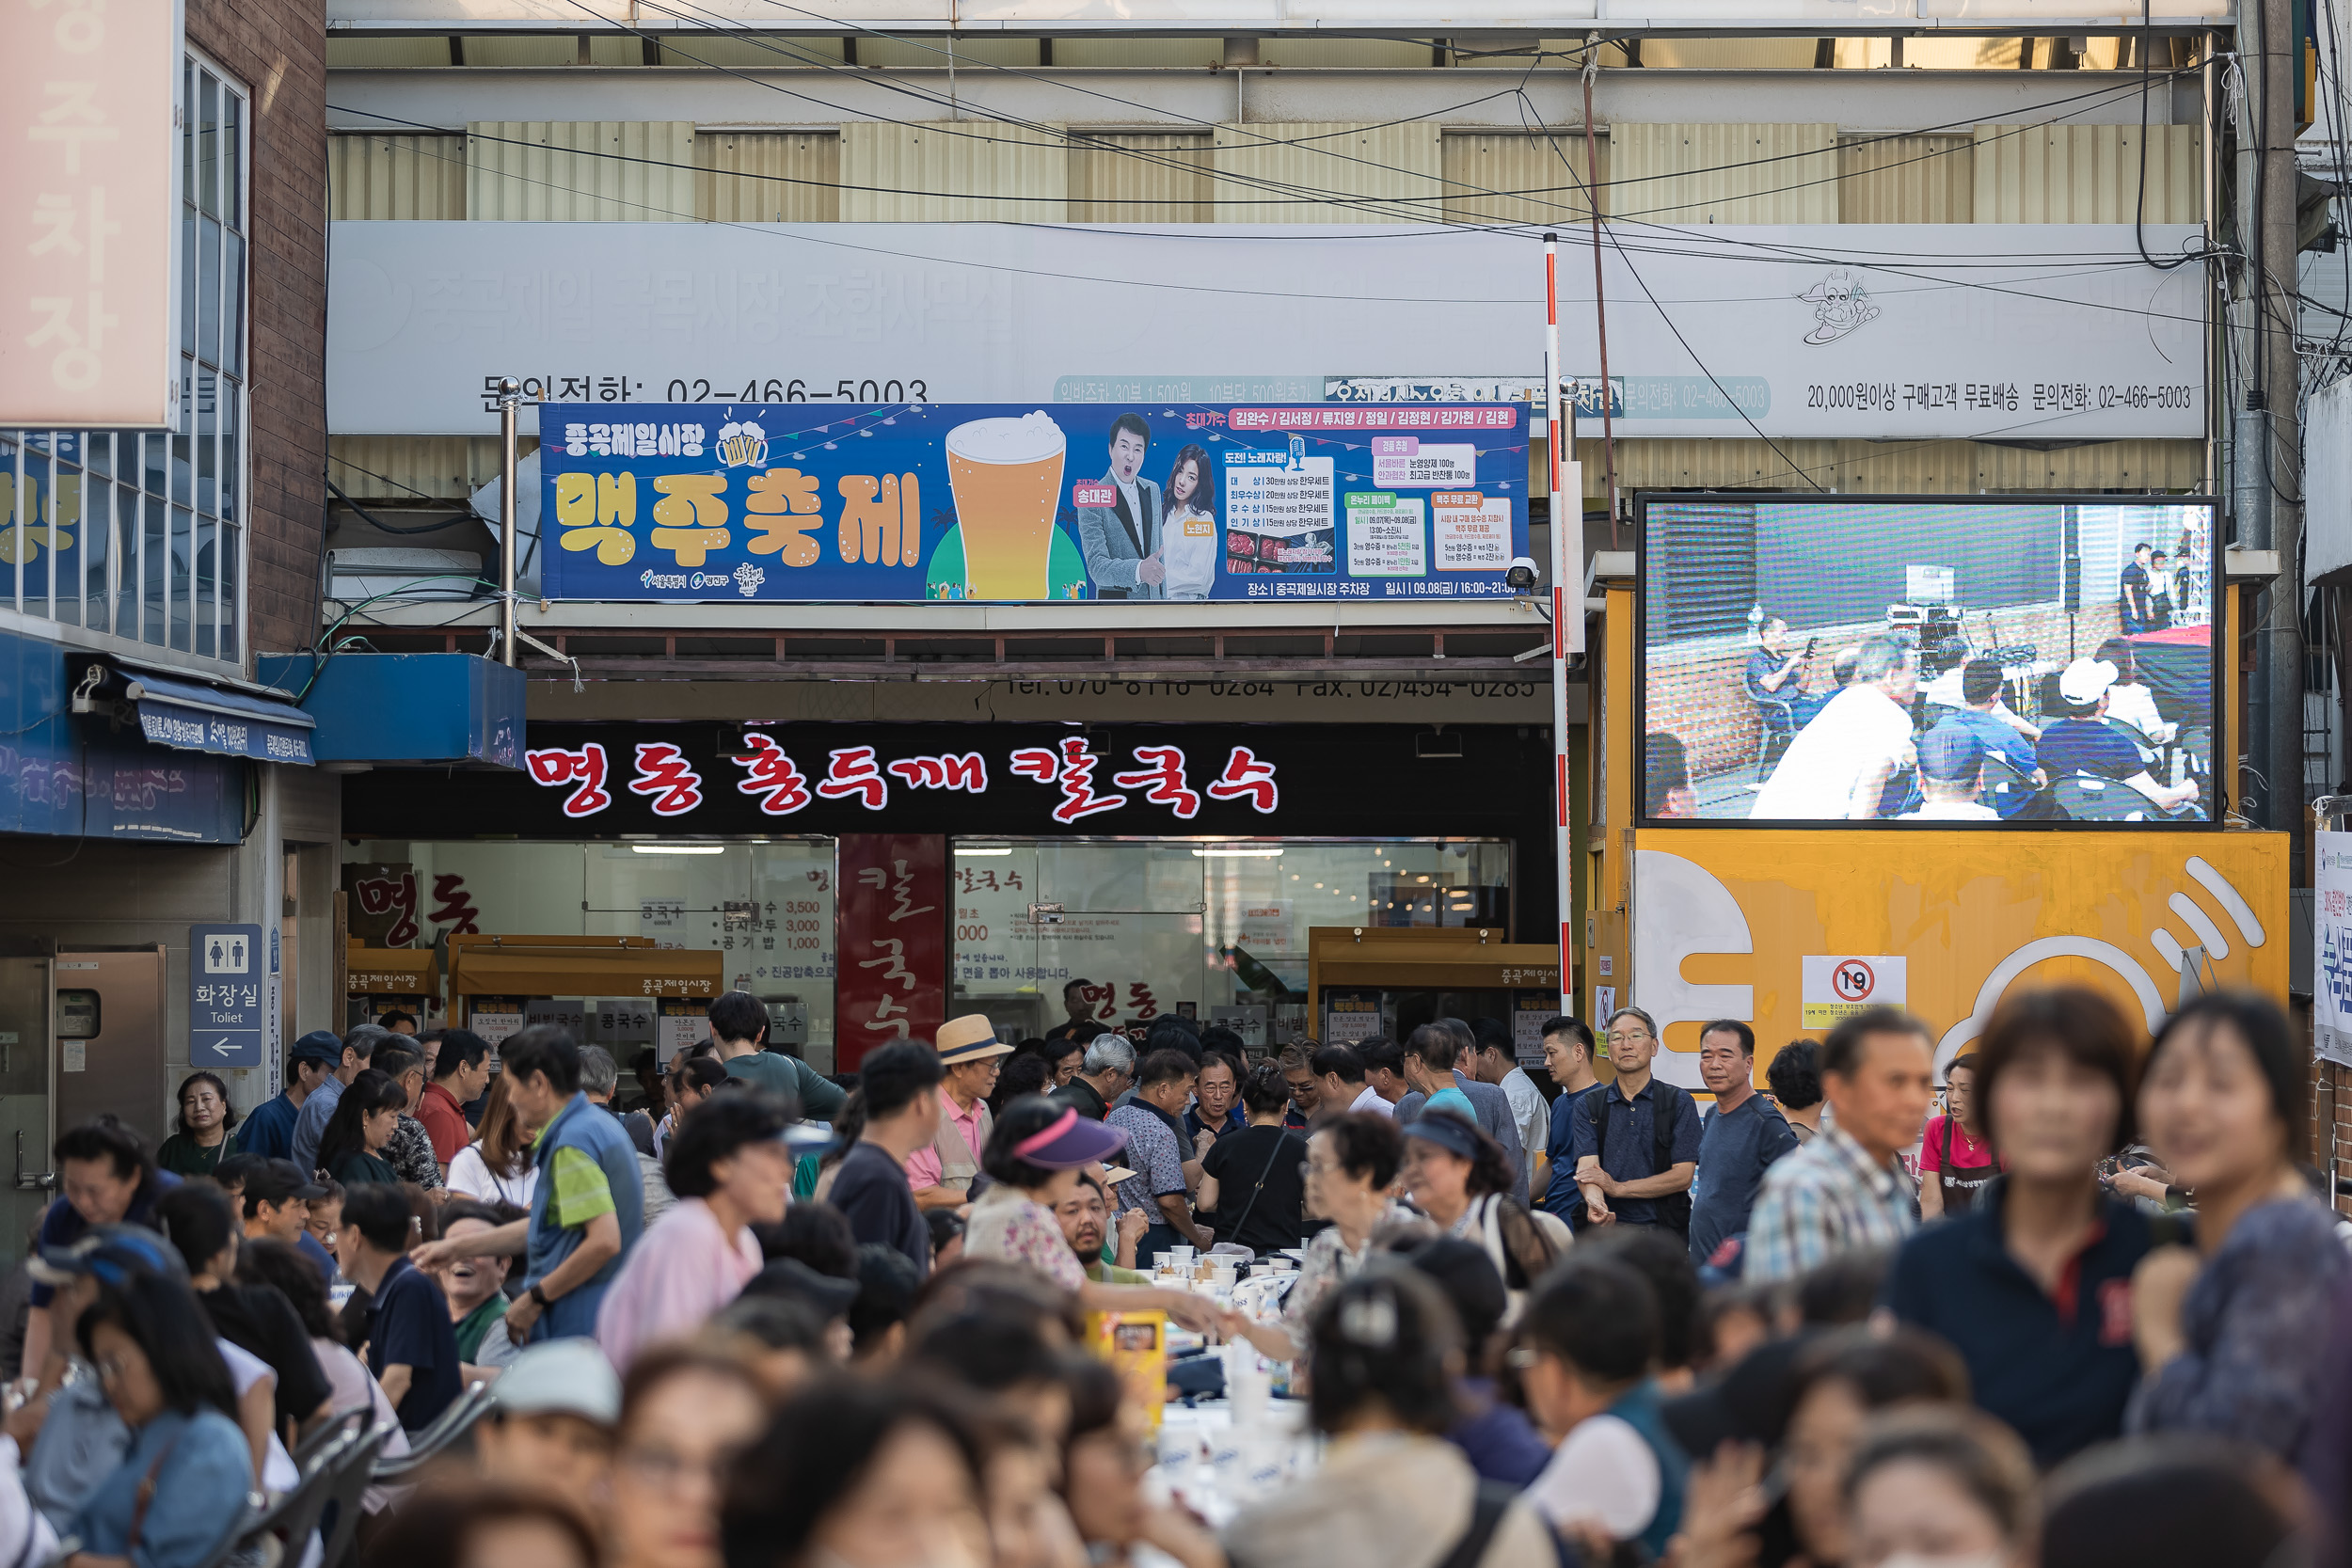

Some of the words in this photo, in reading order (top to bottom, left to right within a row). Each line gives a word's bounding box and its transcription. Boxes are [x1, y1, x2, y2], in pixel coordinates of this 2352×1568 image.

[667, 378, 929, 403] 02-466-5003
[1682, 384, 1765, 409] 02-466-5003
[1807, 381, 1897, 413] 20,000원이상
[1902, 382, 1958, 411] 구매고객
[1963, 382, 2020, 411] 무료배송
[2032, 382, 2093, 411] 문의전화:
[2098, 384, 2192, 410] 02-466-5003
[1185, 412, 1227, 427] 초대가수
[1235, 411, 1269, 426] 김완수
[1279, 411, 1312, 426] 김서정
[1322, 411, 1356, 426] 류지영
[1365, 411, 1388, 426] 정일
[1398, 411, 1431, 426] 김정현
[1440, 411, 1474, 426] 김가현
[1486, 411, 1509, 426] 김현
[564, 422, 706, 457] 중곡제일시장
[1225, 451, 1247, 464] 도전!
[1248, 451, 1287, 464] 노래자랑!
[1409, 458, 1438, 468] 눈영양제
[1299, 476, 1329, 485] 한우세트
[1409, 470, 1431, 481] 최고급
[1077, 488, 1113, 504] 송대관
[1299, 490, 1329, 499] 한우세트
[1451, 494, 1464, 504] 무료
[1465, 494, 1478, 504] 교환
[1298, 504, 1328, 513] 한우세트
[556, 467, 921, 568] 맥주축제
[1298, 517, 1328, 527] 한우세트
[652, 575, 687, 589] 서울특별시
[705, 576, 729, 587] 광진구
[1248, 582, 1268, 596] 장소
[1276, 582, 1337, 596] 중곡제일시장
[1339, 582, 1371, 596] 주차장
[1385, 581, 1406, 595] 일시
[525, 741, 704, 819] 명동
[737, 724, 988, 818] 홍두깨
[1009, 729, 1279, 825] 칼국수
[786, 901, 820, 914] 3,500
[786, 920, 820, 933] 3,000
[787, 937, 820, 950] 1,000
[858, 859, 936, 1040] 칼국수
[348, 974, 418, 990] 중곡제일시장
[642, 979, 712, 995] 중곡제일시장
[1841, 971, 1866, 990] 19
[196, 984, 258, 1007] 화장실
[211, 1011, 244, 1024] Toliet
[600, 1013, 647, 1029] 콩국수
